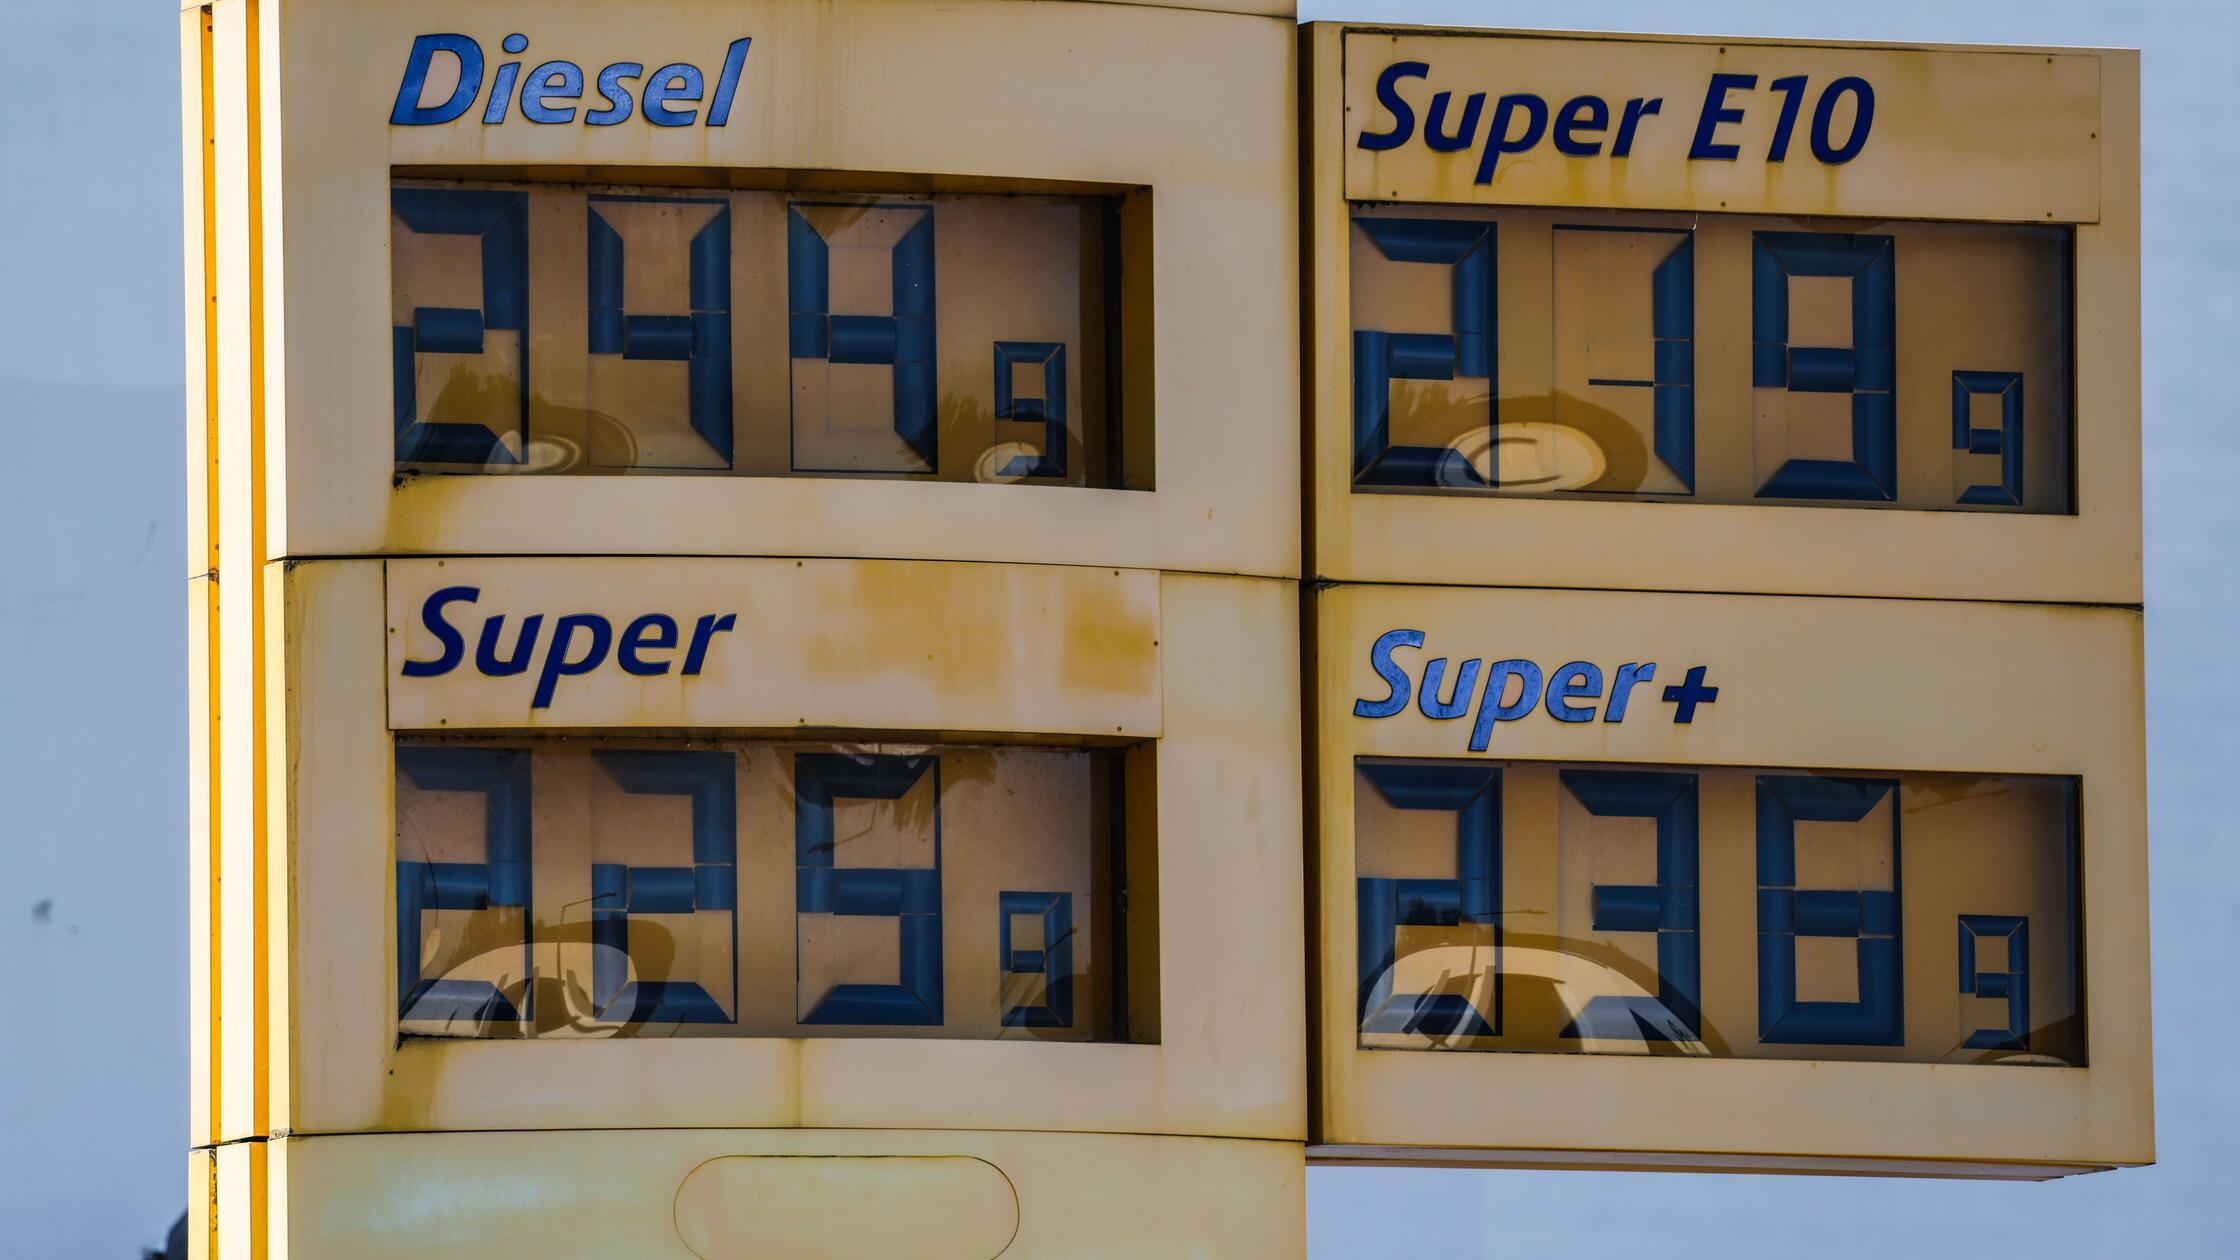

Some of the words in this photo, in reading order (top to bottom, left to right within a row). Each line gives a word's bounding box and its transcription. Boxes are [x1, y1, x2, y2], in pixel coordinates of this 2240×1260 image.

[390, 33, 752, 127] Diesel
[1357, 61, 1663, 186] Super
[1688, 73, 1876, 165] E10
[401, 585, 737, 709] Super
[1353, 629, 1719, 752] Super+
